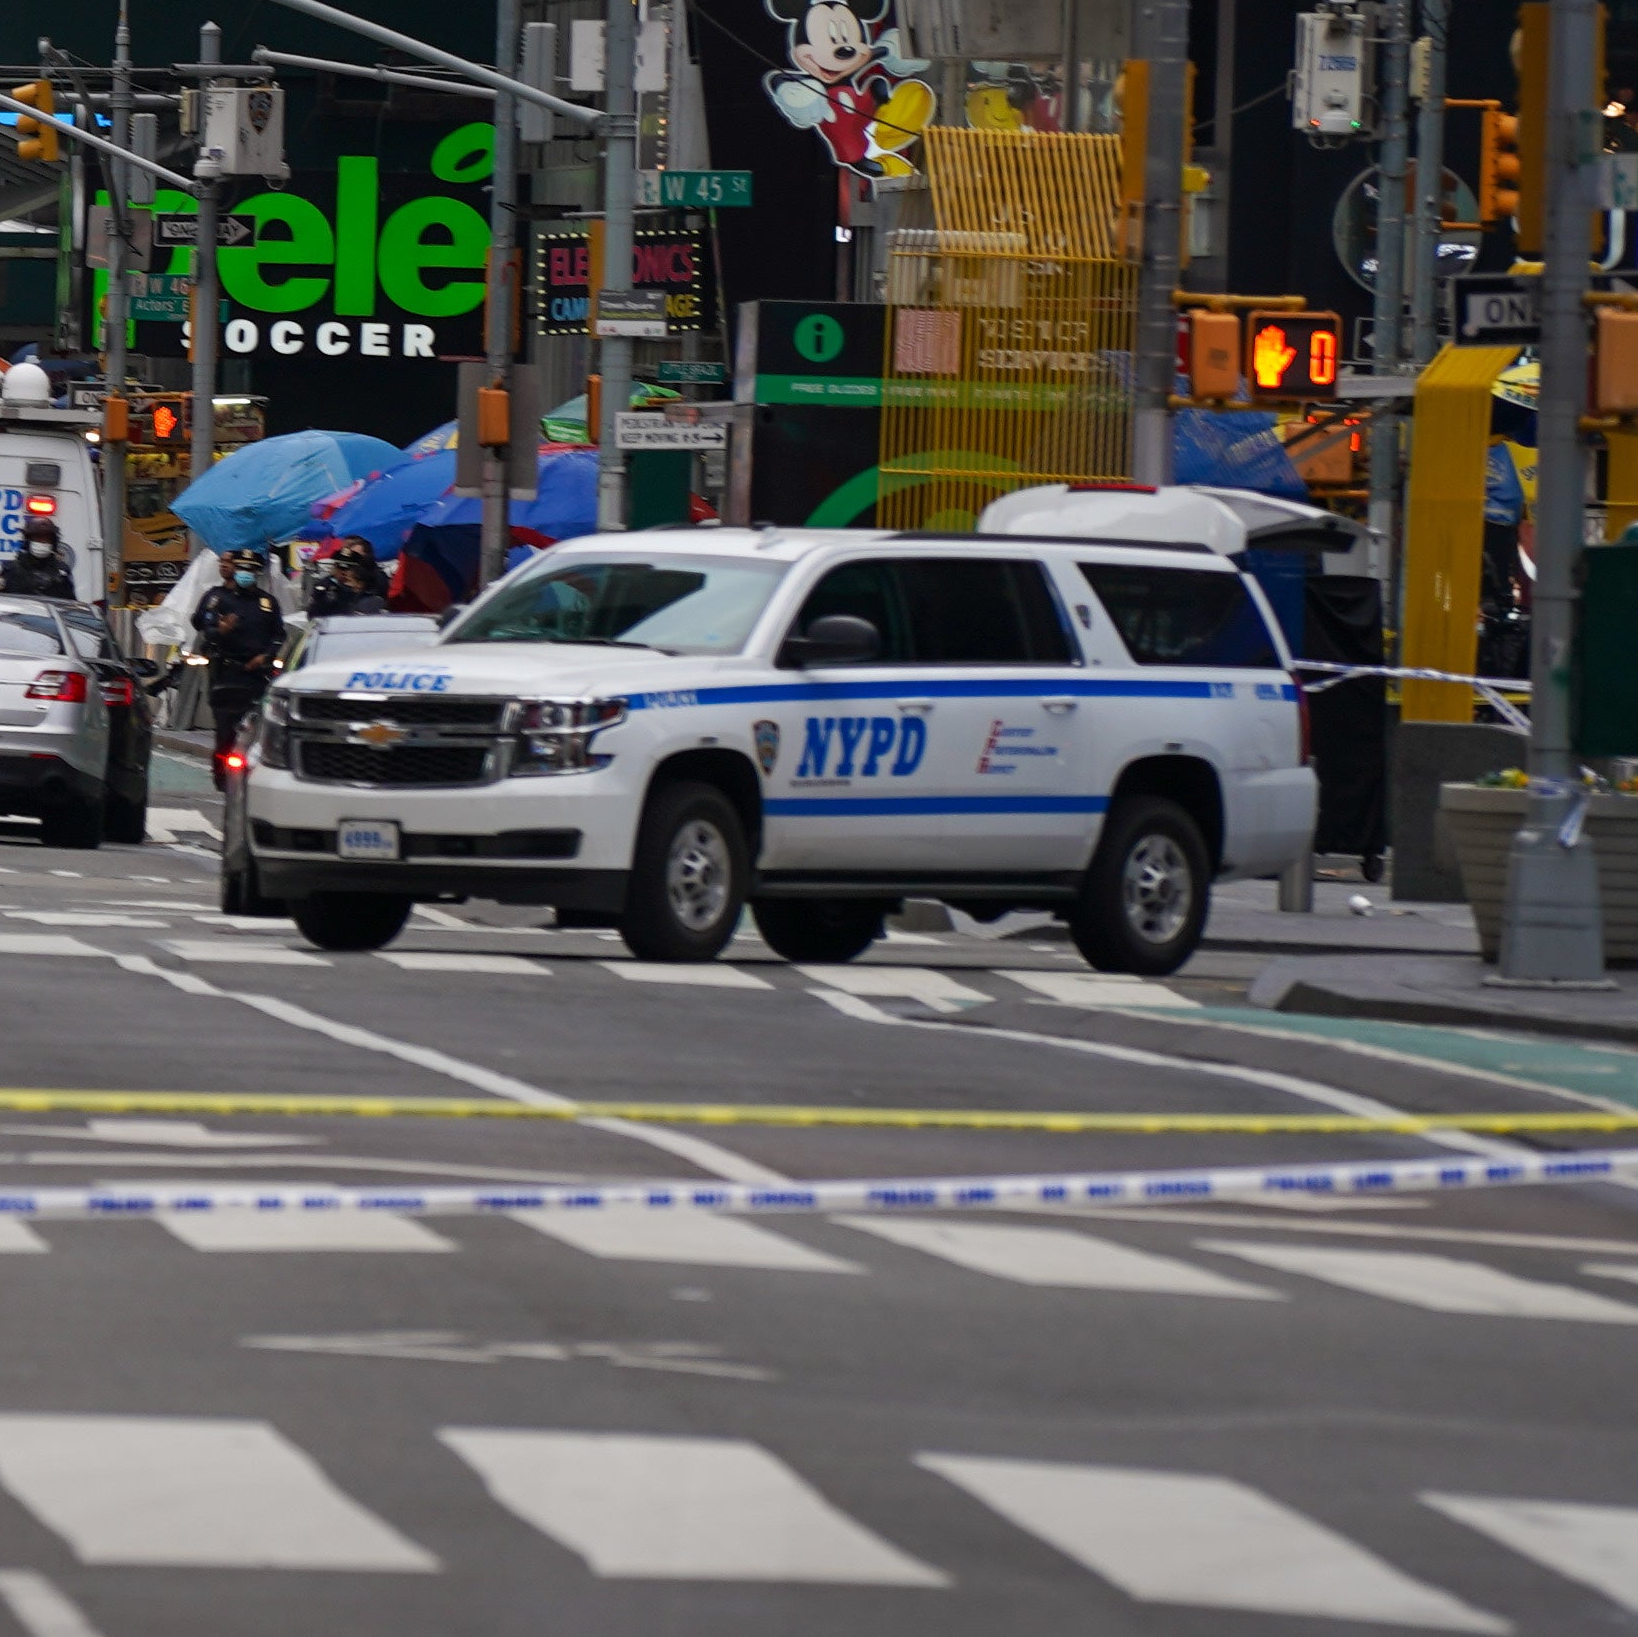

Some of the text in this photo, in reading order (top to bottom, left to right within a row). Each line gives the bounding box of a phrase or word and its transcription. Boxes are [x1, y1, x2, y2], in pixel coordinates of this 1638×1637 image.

[664, 177, 685, 201] W
[697, 176, 723, 202] 45
[550, 246, 693, 285] ELEONICS
[345, 671, 453, 692] POLICE
[795, 715, 927, 779] NYPD
